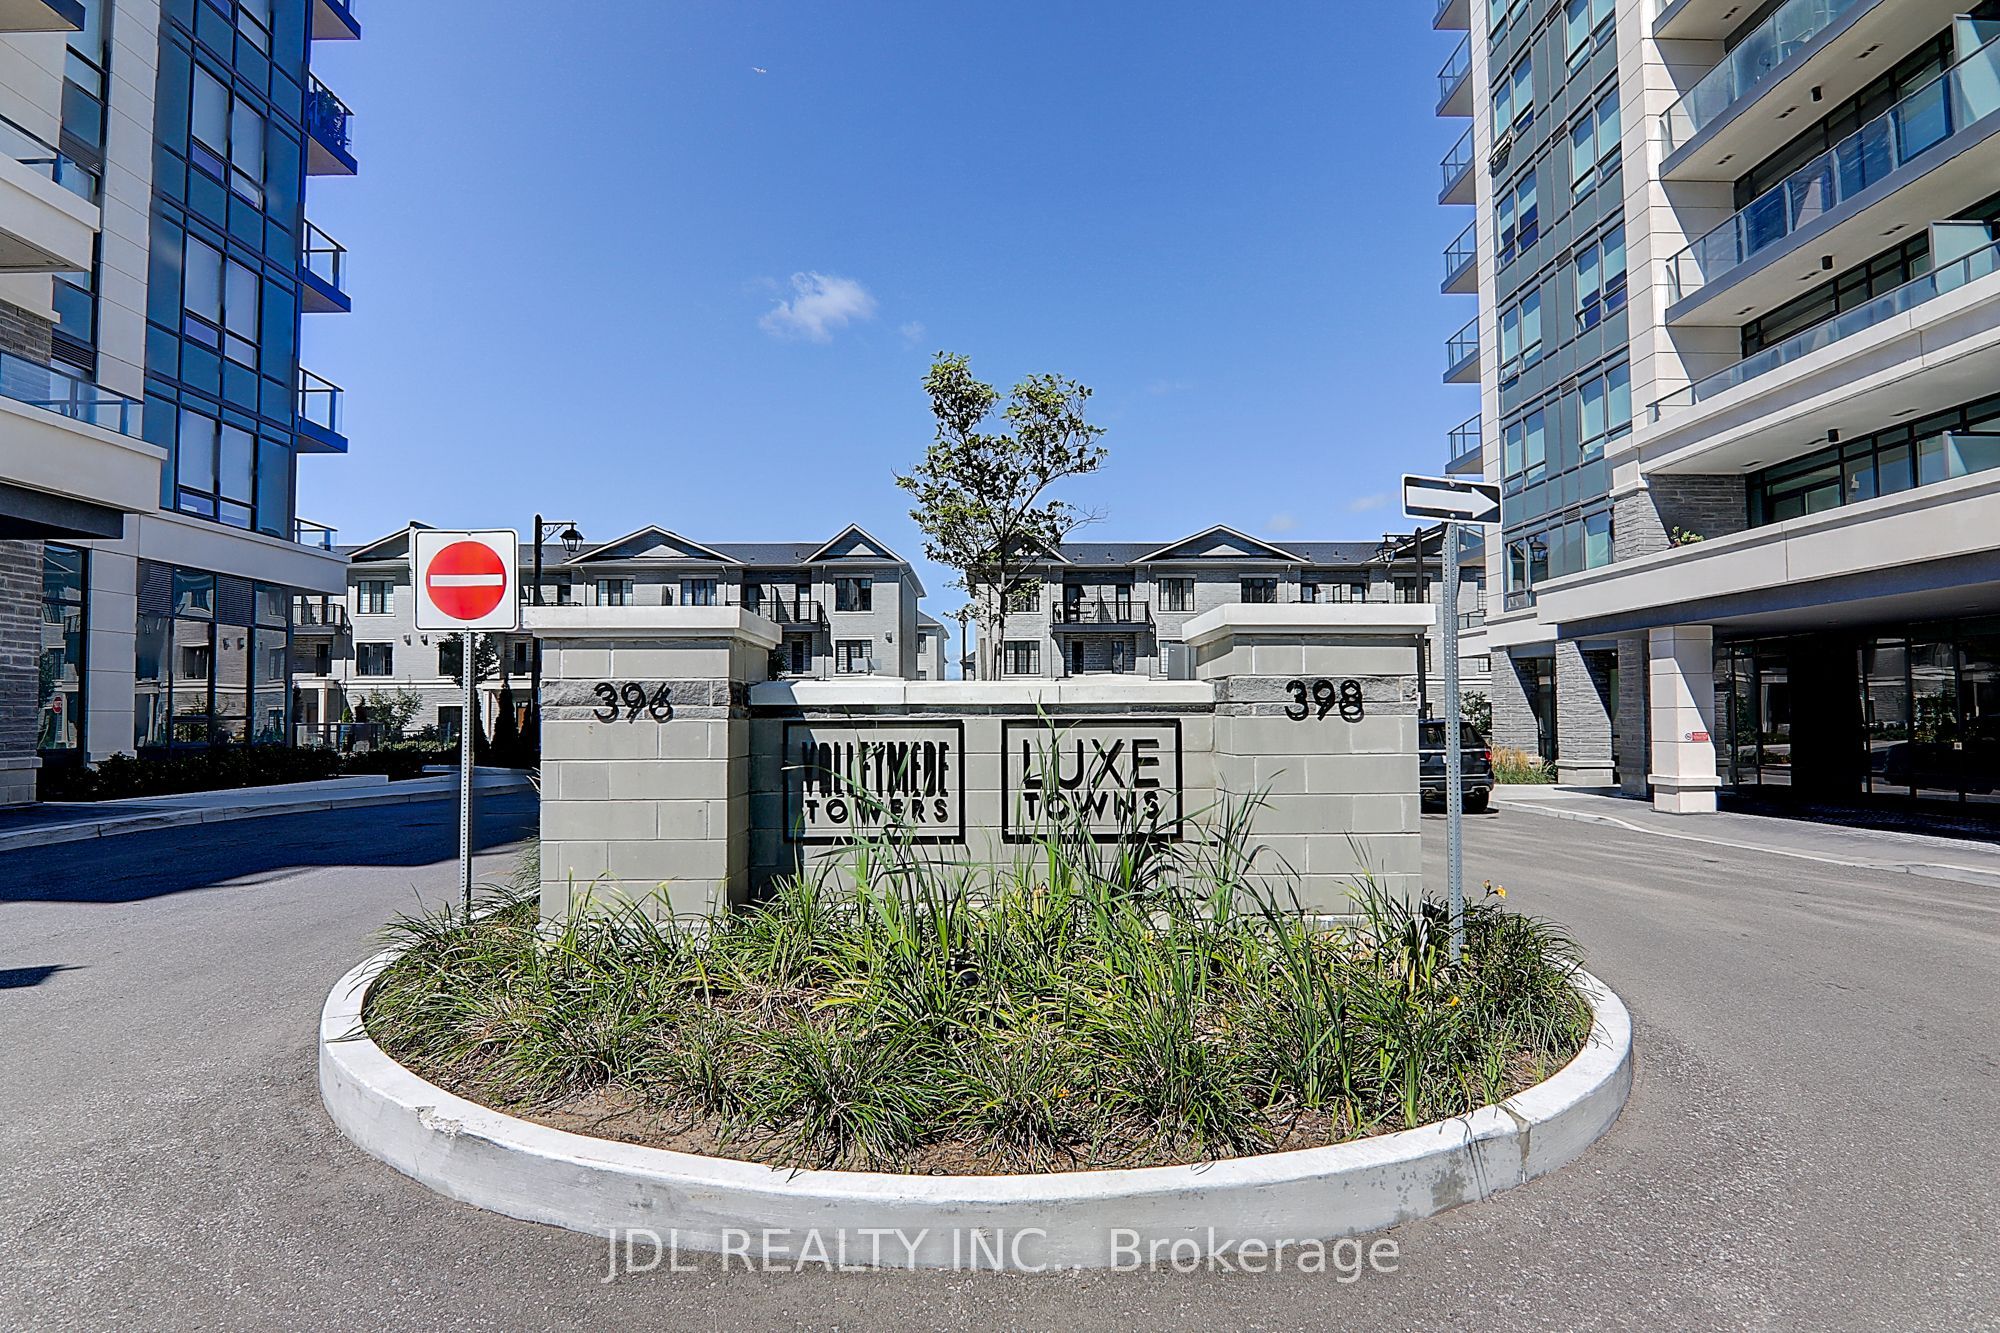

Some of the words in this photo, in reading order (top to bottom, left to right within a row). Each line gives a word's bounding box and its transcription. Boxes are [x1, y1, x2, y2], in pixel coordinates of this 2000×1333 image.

[593, 682, 674, 724] 396
[1284, 679, 1364, 723] 398
[1022, 738, 1160, 790] LUXE
[805, 799, 949, 826] TOWERS
[1022, 790, 1160, 821] TOWNS
